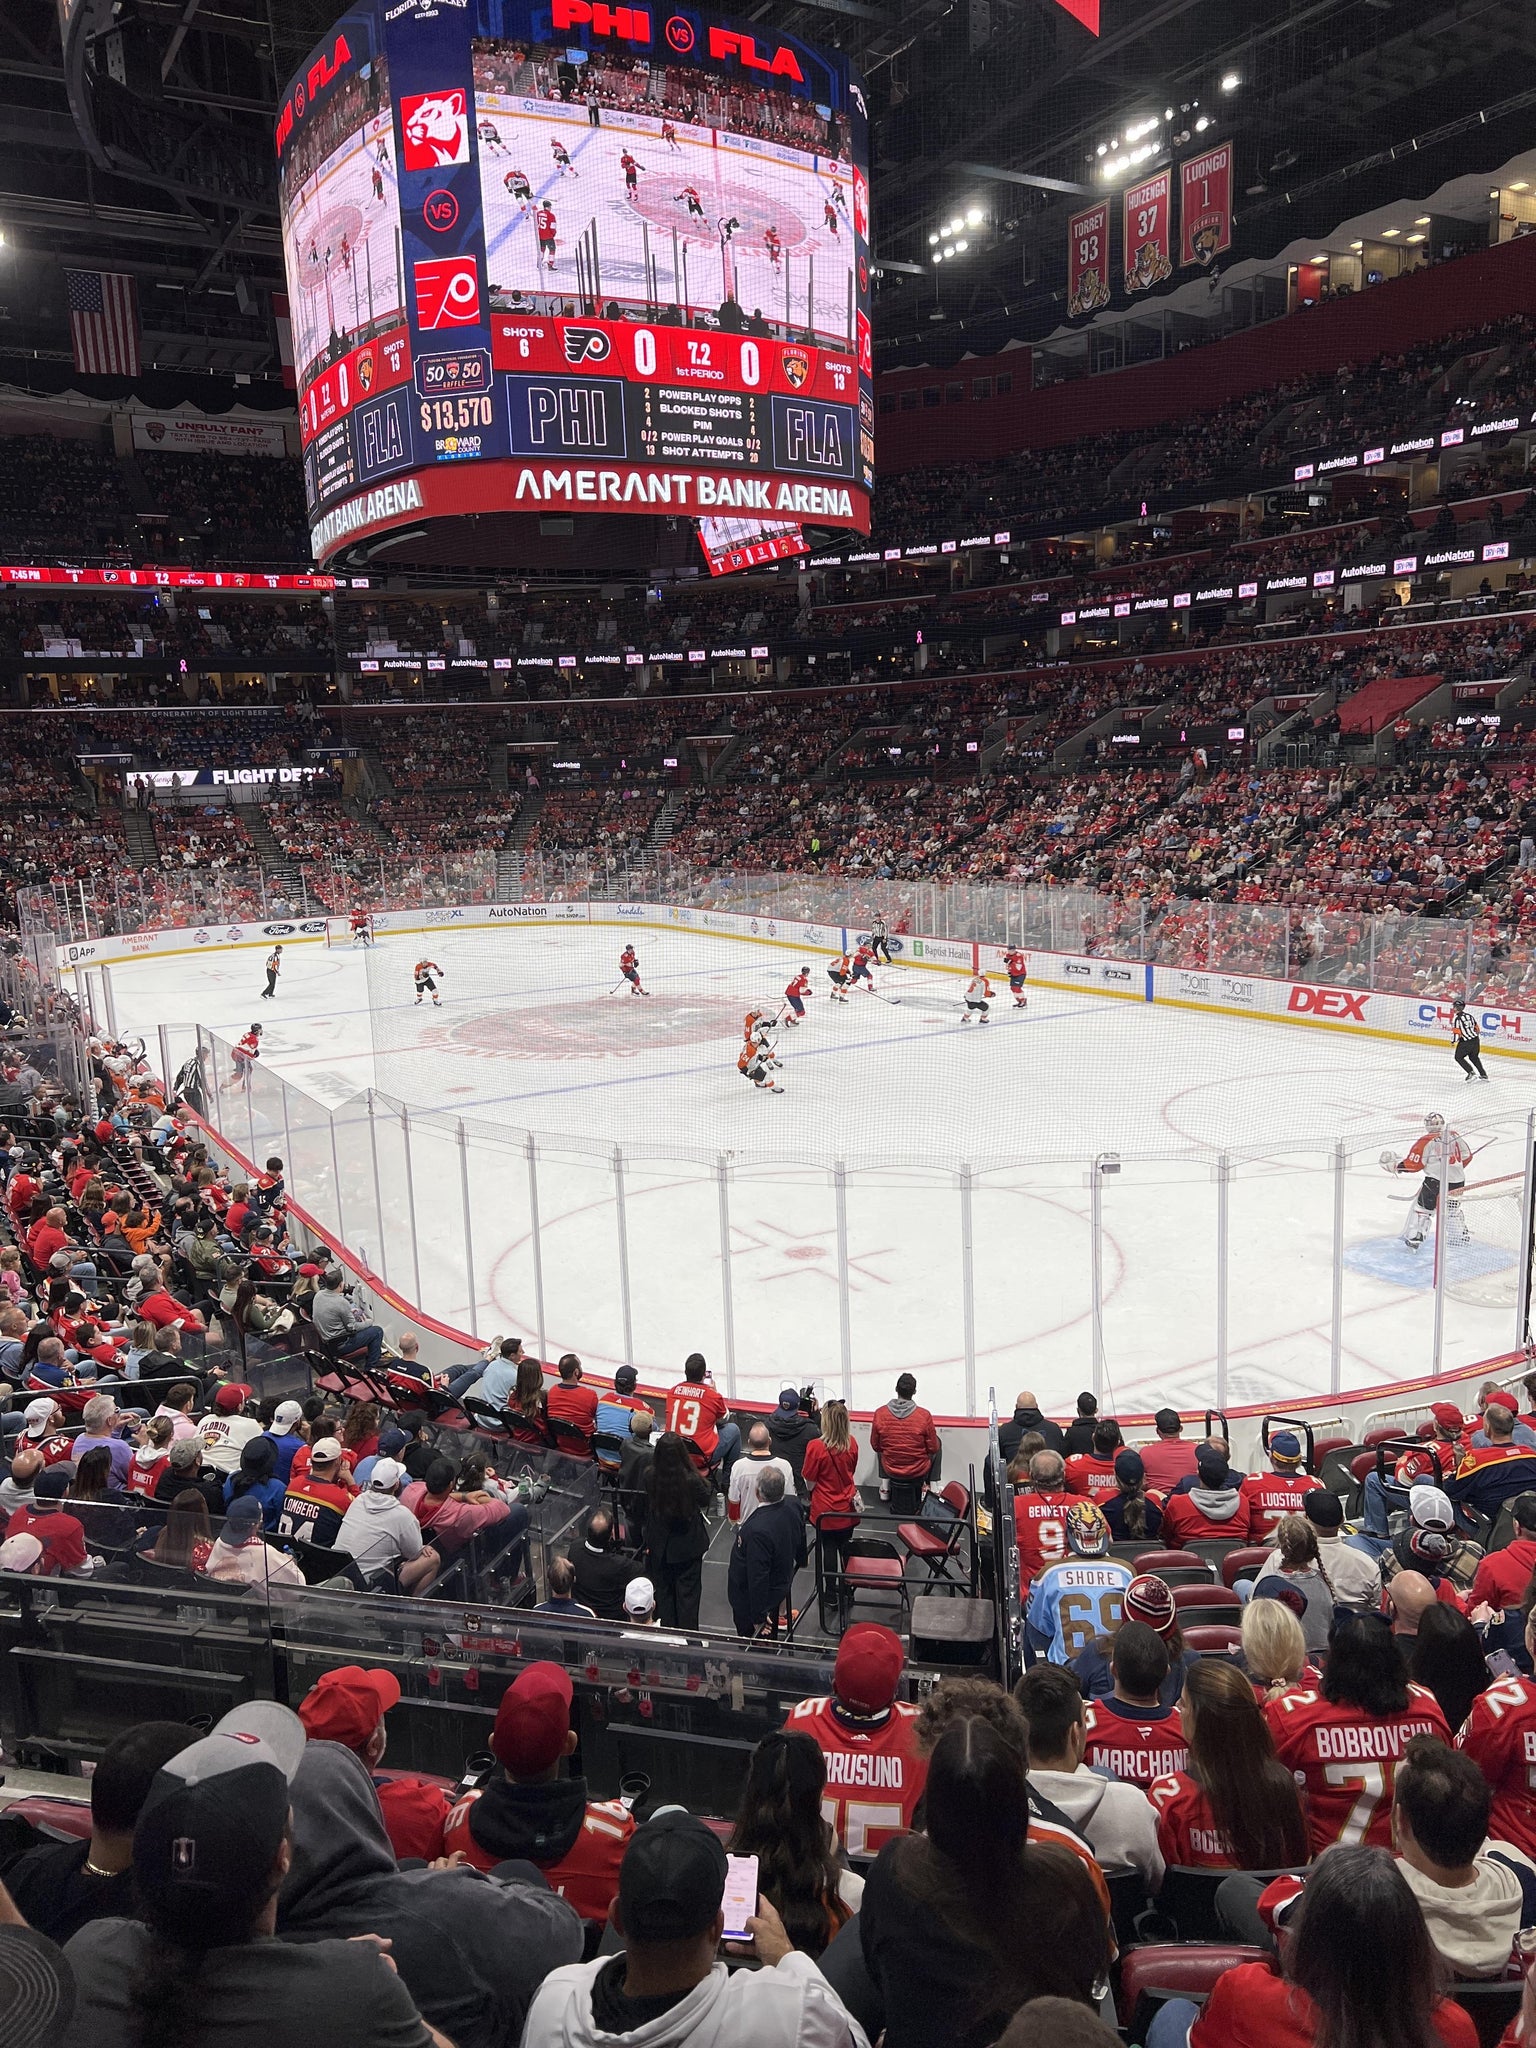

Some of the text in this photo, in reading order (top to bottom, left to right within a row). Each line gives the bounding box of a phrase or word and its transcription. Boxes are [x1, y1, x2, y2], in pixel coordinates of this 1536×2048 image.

[551, 0, 650, 43] PHI
[708, 27, 804, 82] FLA
[307, 34, 352, 100] FLA
[1186, 152, 1227, 184] LUONGO
[1128, 180, 1166, 211] HUIZENGA
[1201, 179, 1210, 208] 1
[430, 203, 453, 221] VS
[1074, 212, 1104, 238] TORREY
[1138, 205, 1158, 237] 37
[1079, 235, 1098, 265] 93
[503, 327, 544, 338] SHOTS
[384, 339, 404, 356] SHOTS
[519, 338, 530, 358] 6
[634, 329, 656, 376] 0
[687, 342, 711, 366] 7.2
[390, 352, 400, 372] 13
[740, 341, 760, 386] 0
[825, 361, 852, 374] SHOTS
[426, 362, 480, 382] 50 50
[676, 367, 724, 380] 1st PERIOD
[833, 373, 845, 390] 13
[644, 387, 755, 408] 2 POWER PLAY OPPS 2
[420, 396, 492, 432] $13,570
[528, 386, 607, 446] PHI
[645, 402, 755, 422] 3 BLOCKED SHOTS 2
[175, 422, 264, 436] UNRULY FAN?
[646, 416, 756, 435] 4 PIM 4
[1471, 417, 1519, 435] AutoNation
[363, 402, 403, 468] FLA
[661, 432, 692, 443] POWER
[692, 434, 715, 445] PLAY
[716, 437, 744, 447] GOALS
[786, 407, 843, 466] FLA
[1390, 437, 1434, 454] AutoNation
[646, 444, 759, 463] 13 SHOT ATTEMPTS 20
[1318, 455, 1357, 471] AutoNation
[515, 469, 853, 517] AMERANT BANK ARENA
[335, 497, 364, 536] BANK
[367, 480, 422, 522] ARENA
[905, 544, 937, 556] AutoNation
[960, 536, 990, 549] AutoNation
[809, 555, 841, 566] AutoNation
[848, 552, 880, 563] AutoNation
[1424, 549, 1476, 565] AutoNation
[10, 570, 41, 580] 7:45 PM
[130, 572, 137, 583] 0
[1341, 563, 1386, 578] AutoNation
[155, 573, 170, 584] 7.2
[215, 573, 223, 586] 0
[268, 579, 277, 588] 13
[1267, 576, 1307, 589] AutoNation
[1196, 588, 1233, 601] AutoNation
[1135, 598, 1168, 610] AutoNation
[1079, 607, 1110, 619] AutoNation
[585, 656, 620, 664] AutoNation
[649, 653, 684, 661] AutoNation
[711, 649, 746, 658] AutoNation
[384, 661, 421, 669] AutoNation
[451, 660, 488, 668] AutoNation
[517, 658, 553, 666] AutoNation
[1456, 688, 1467, 697] 118
[221, 709, 245, 717] LIGHT
[1456, 715, 1501, 726] Autoation
[1112, 735, 1140, 743] AutoNation
[212, 769, 276, 785] FLIGHT
[489, 906, 547, 917] AutoNation
[122, 934, 158, 945] AMERANT
[131, 944, 150, 952] BANK
[925, 945, 971, 959] Baptist Health
[1068, 965, 1077, 973] Air
[1117, 972, 1129, 980] Pros
[1179, 988, 1209, 998] chiropractic
[1221, 994, 1254, 1004] chiropractic
[1287, 986, 1371, 1021] DEX
[1419, 1004, 1455, 1025] CH
[1408, 1019, 1431, 1029] Cooper
[1482, 1012, 1521, 1034] CH
[1507, 1033, 1532, 1043] Hunter
[1410, 1153, 1420, 1163] 80
[674, 1385, 706, 1398] REINHART
[670, 1399, 701, 1436] 13
[199, 1421, 230, 1437] FLORIDA
[49, 1436, 69, 1456] 42
[132, 1470, 154, 1486] BENNETT
[1088, 1474, 1118, 1487] BARKO
[1261, 1492, 1304, 1508] LUOSTAR
[284, 1497, 320, 1519] LOMBERG
[1028, 1505, 1070, 1519] BENNETT
[1039, 1520, 1064, 1559] 9
[1067, 1571, 1115, 1586] SHORE
